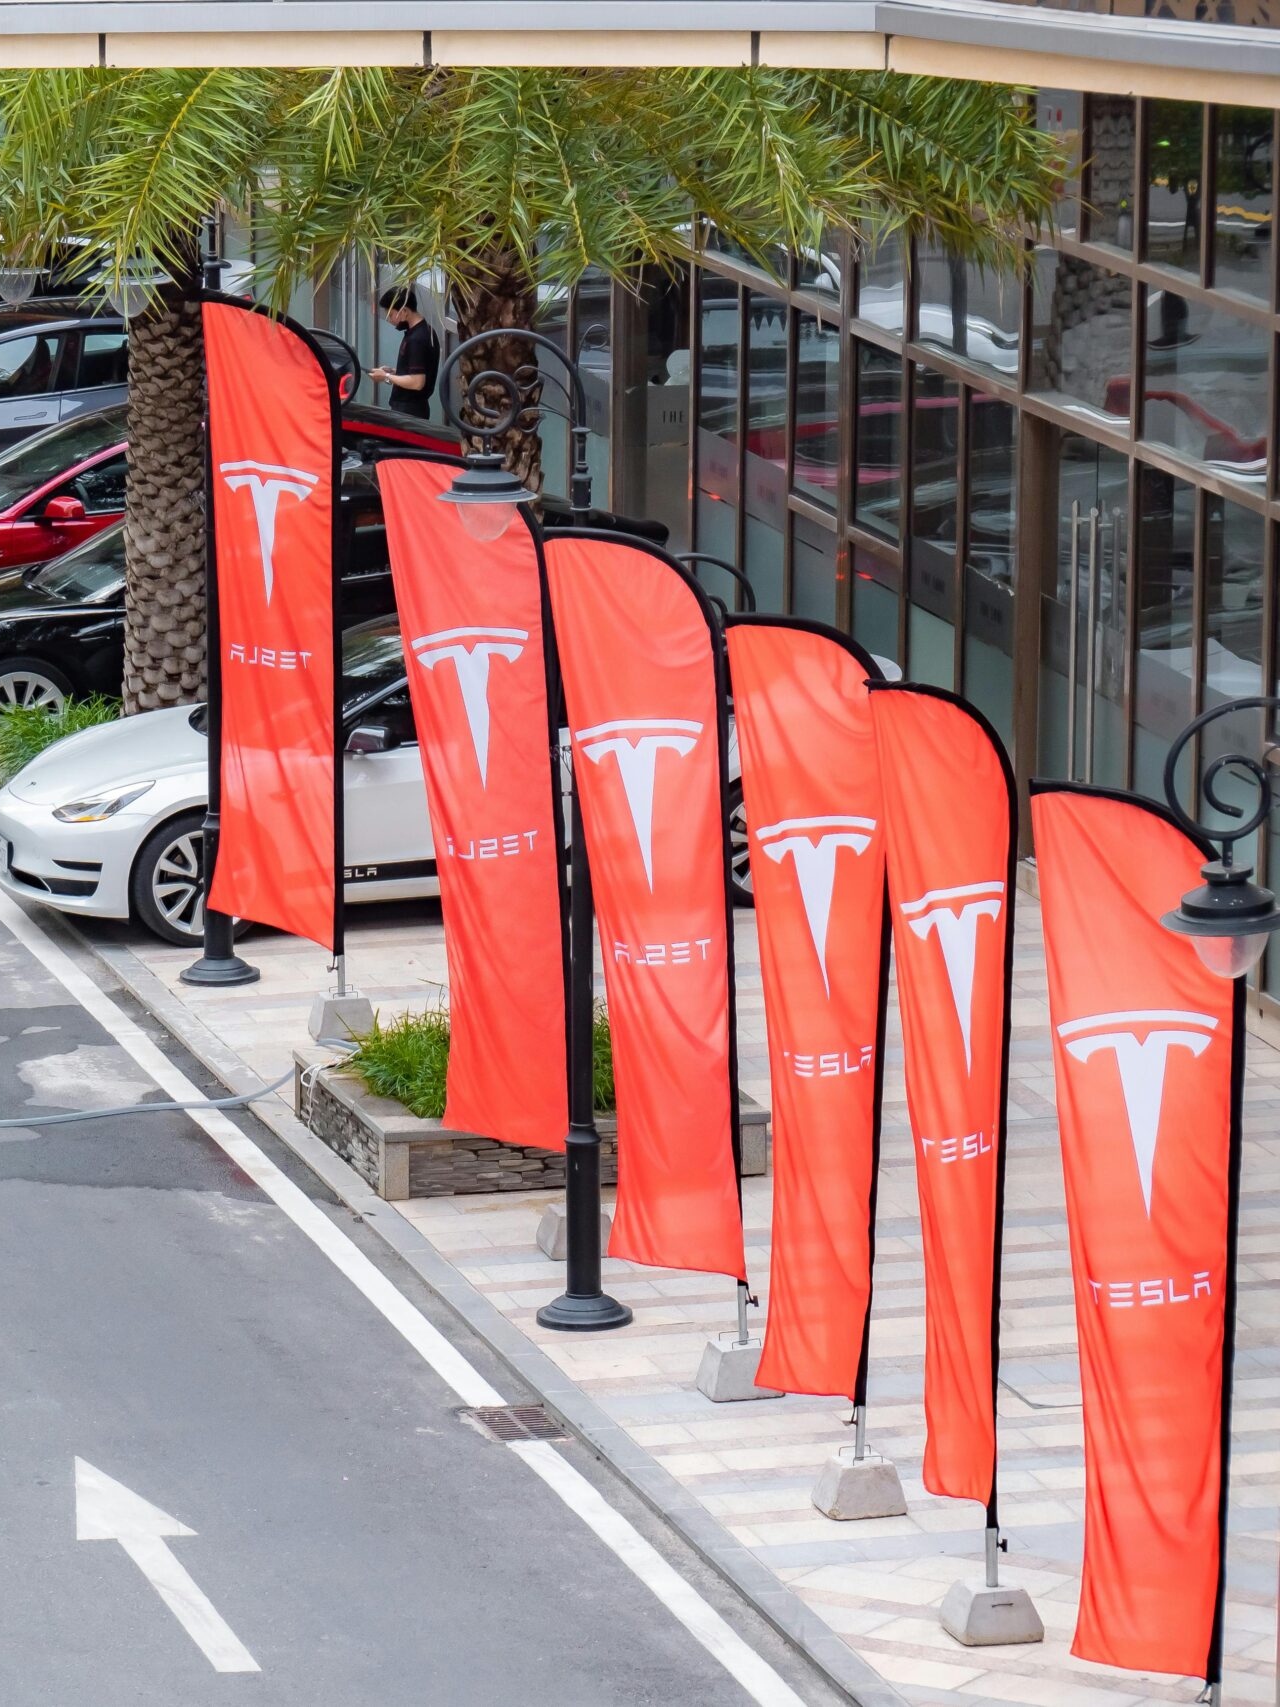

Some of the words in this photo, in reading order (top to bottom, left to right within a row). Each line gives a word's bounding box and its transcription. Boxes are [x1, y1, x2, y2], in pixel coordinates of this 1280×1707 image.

[344, 867, 377, 878] SLA
[783, 1045, 873, 1077] ESLA
[921, 1129, 995, 1163] TESL
[1088, 1271, 1211, 1308] TESLA
